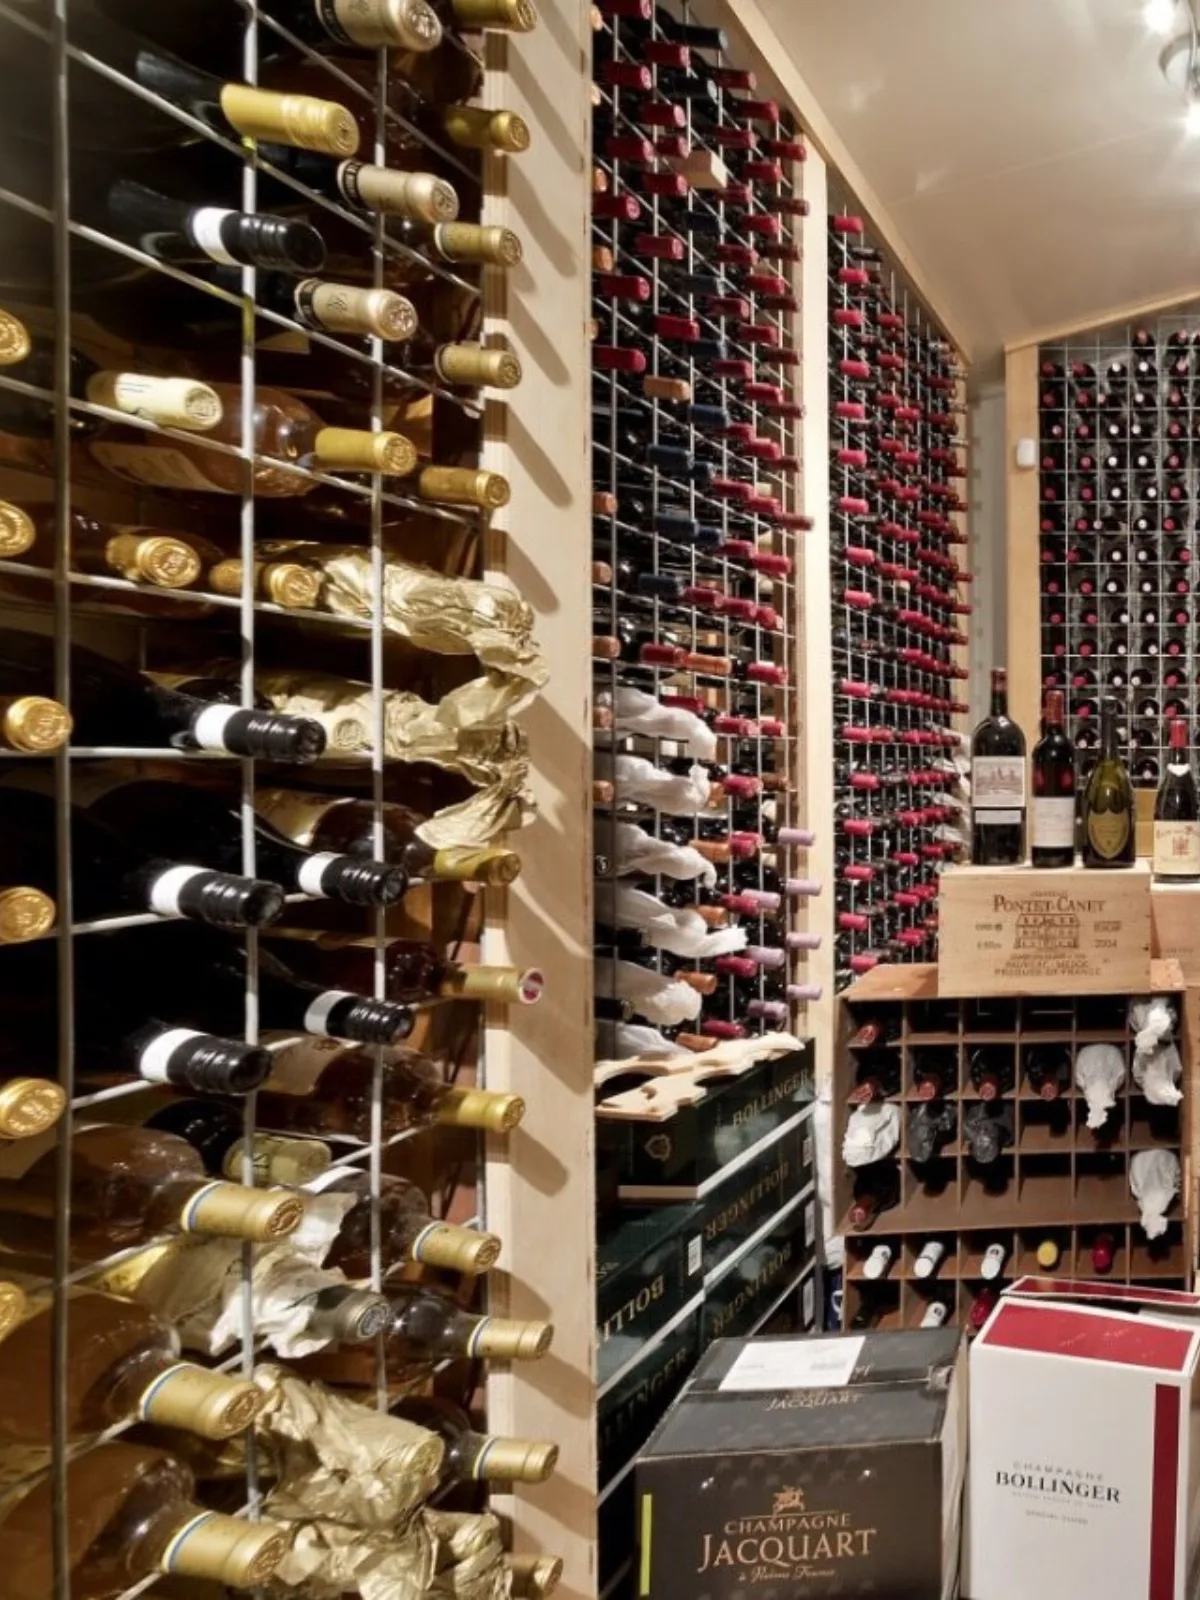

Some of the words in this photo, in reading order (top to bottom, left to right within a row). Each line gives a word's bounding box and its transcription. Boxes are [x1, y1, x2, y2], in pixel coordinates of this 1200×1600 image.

[732, 1068, 808, 1129] BOLLINGER
[996, 1470, 1120, 1503] BOLLINGER
[723, 1512, 852, 1535] CHAMPAGNE
[697, 1528, 877, 1573] JACQUART
